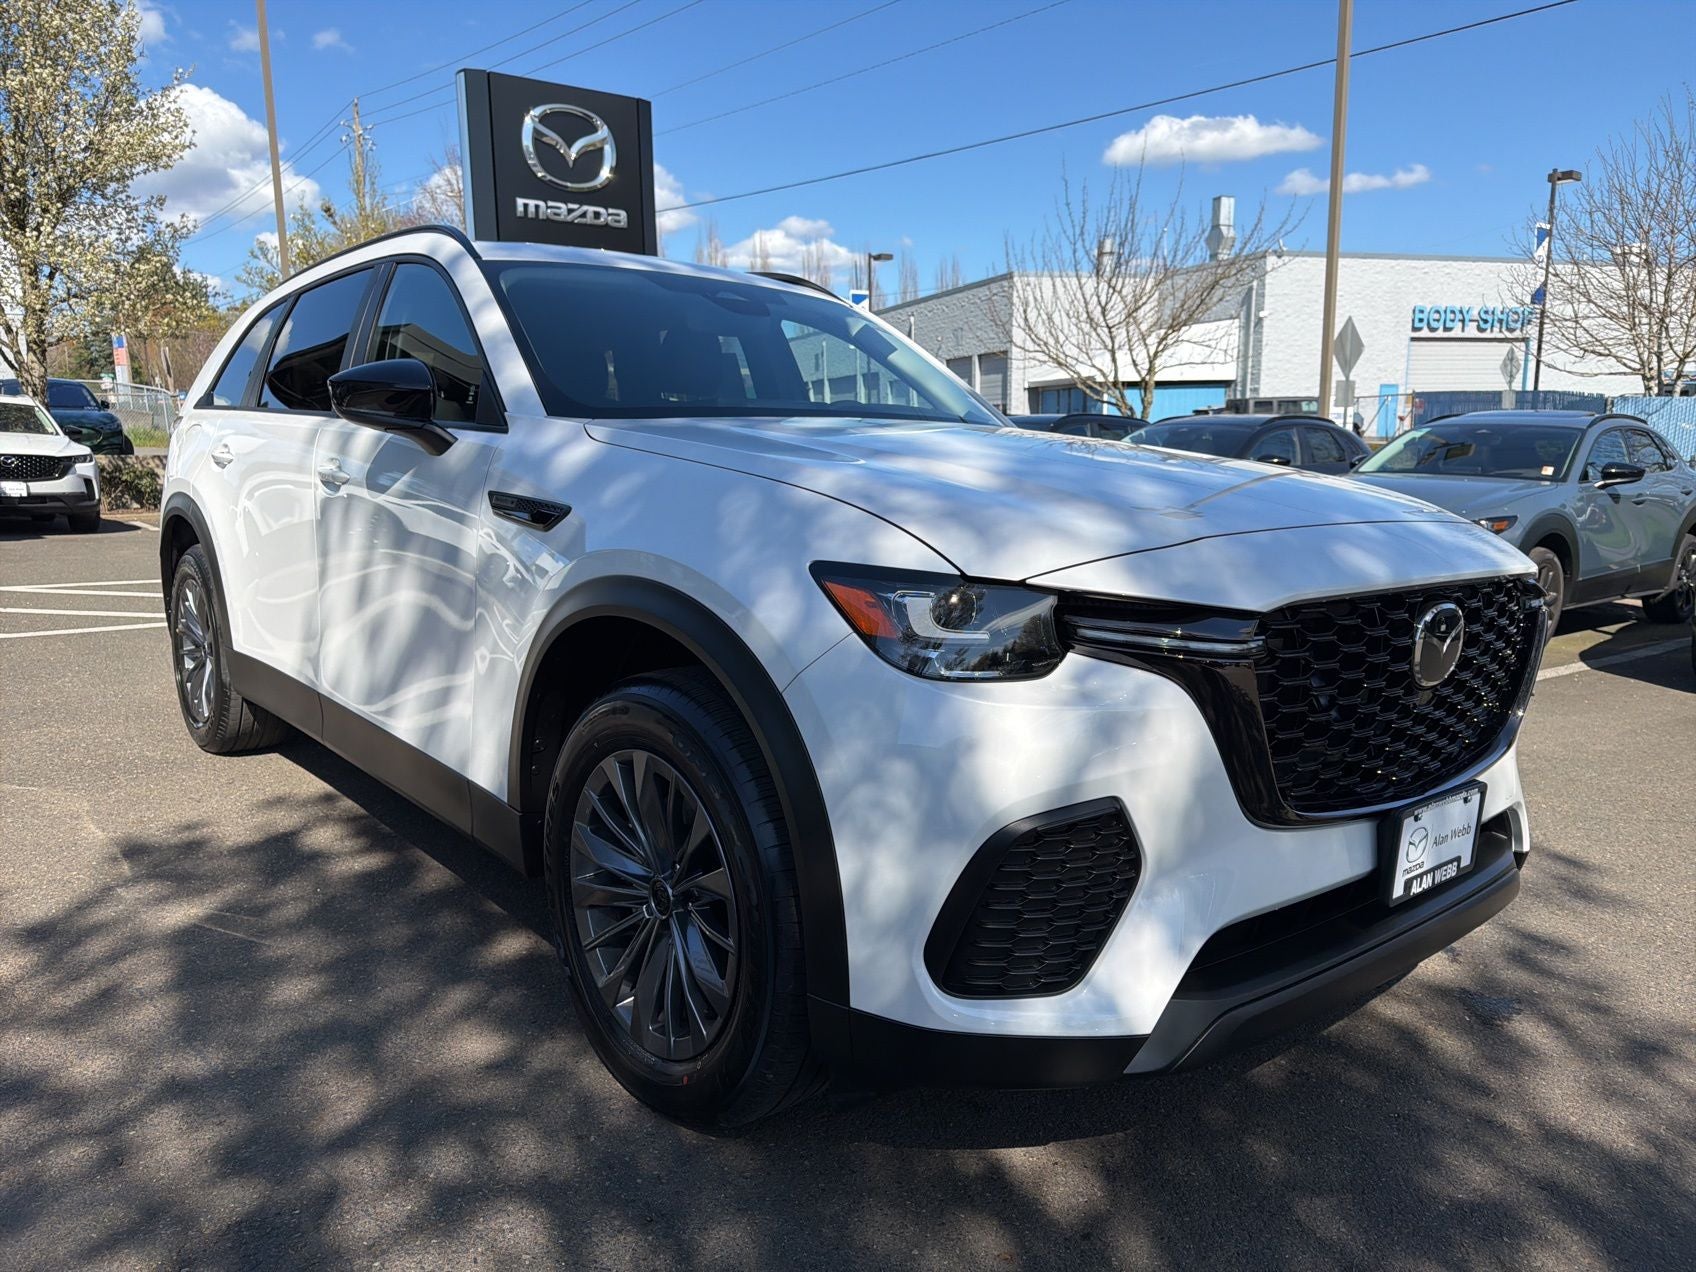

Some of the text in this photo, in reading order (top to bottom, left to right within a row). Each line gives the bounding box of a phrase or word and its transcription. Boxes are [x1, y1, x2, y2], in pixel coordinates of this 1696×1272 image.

[1412, 304, 1534, 333] BODY SHOP
[1431, 822, 1472, 849] Alan Webb
[1410, 861, 1458, 896] ALAN WEBB
